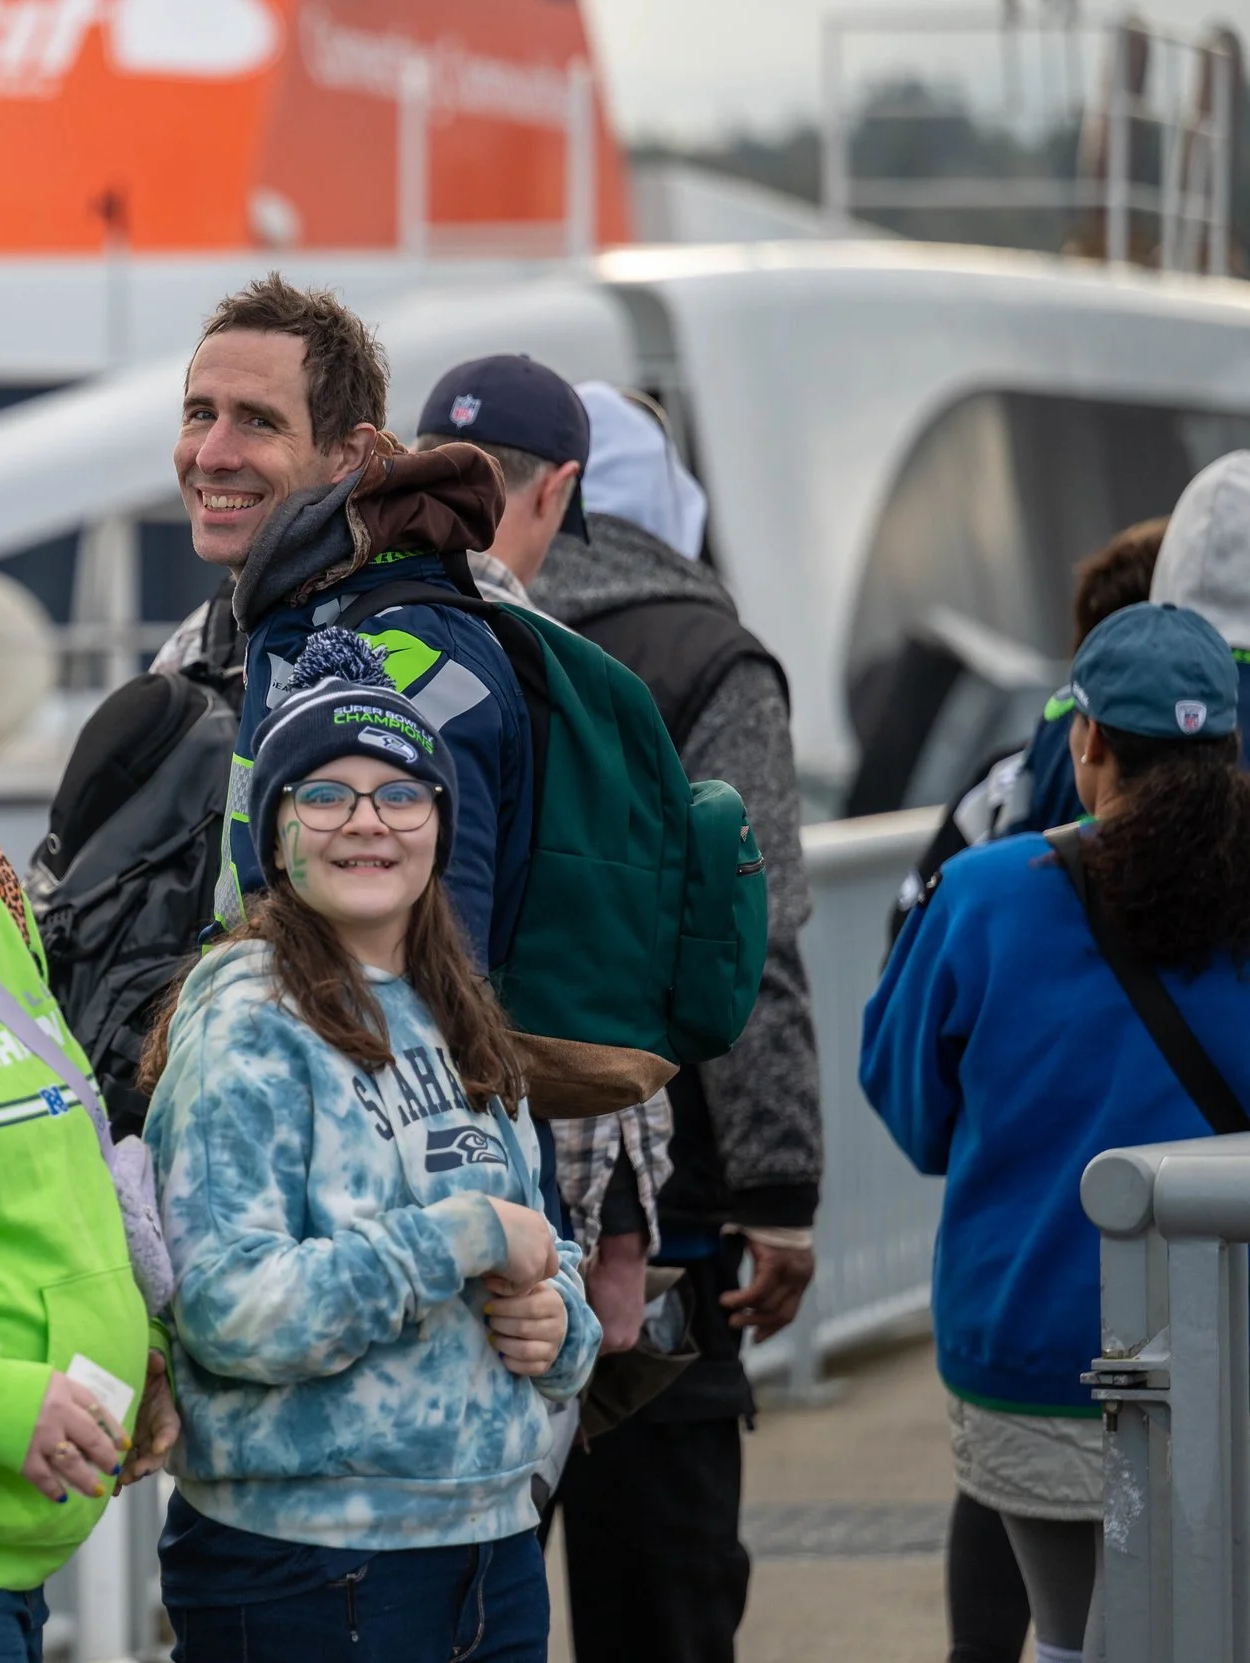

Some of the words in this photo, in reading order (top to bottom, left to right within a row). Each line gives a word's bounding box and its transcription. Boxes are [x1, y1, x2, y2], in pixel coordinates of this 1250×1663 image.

[333, 704, 383, 716] SUPER
[385, 710, 421, 734] BOWL
[333, 712, 434, 755] CHAMPIONS
